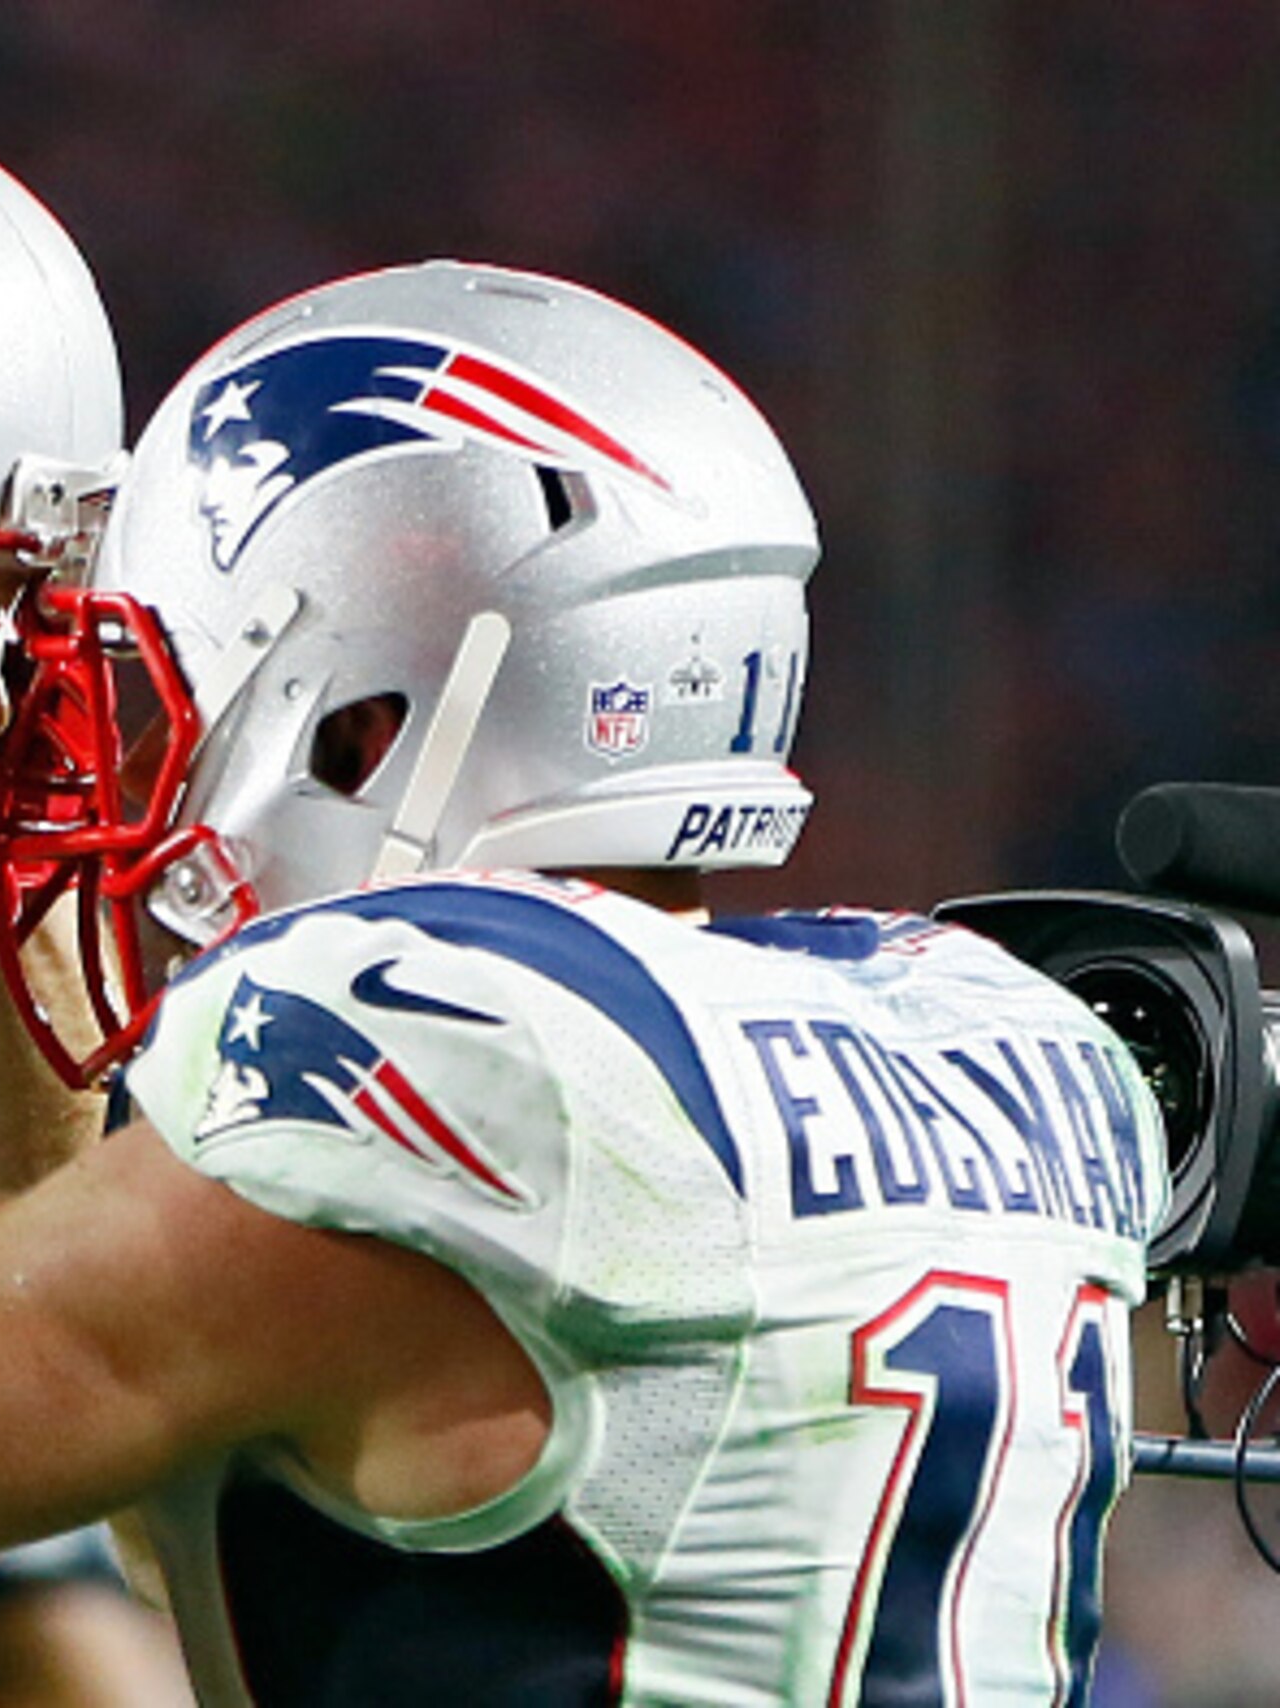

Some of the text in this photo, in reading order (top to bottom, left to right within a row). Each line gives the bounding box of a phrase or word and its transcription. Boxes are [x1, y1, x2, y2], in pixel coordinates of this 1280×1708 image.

[594, 715, 640, 748] NFL
[739, 1019, 1148, 1242] EDELMAN
[827, 1268, 1120, 1708] 11
